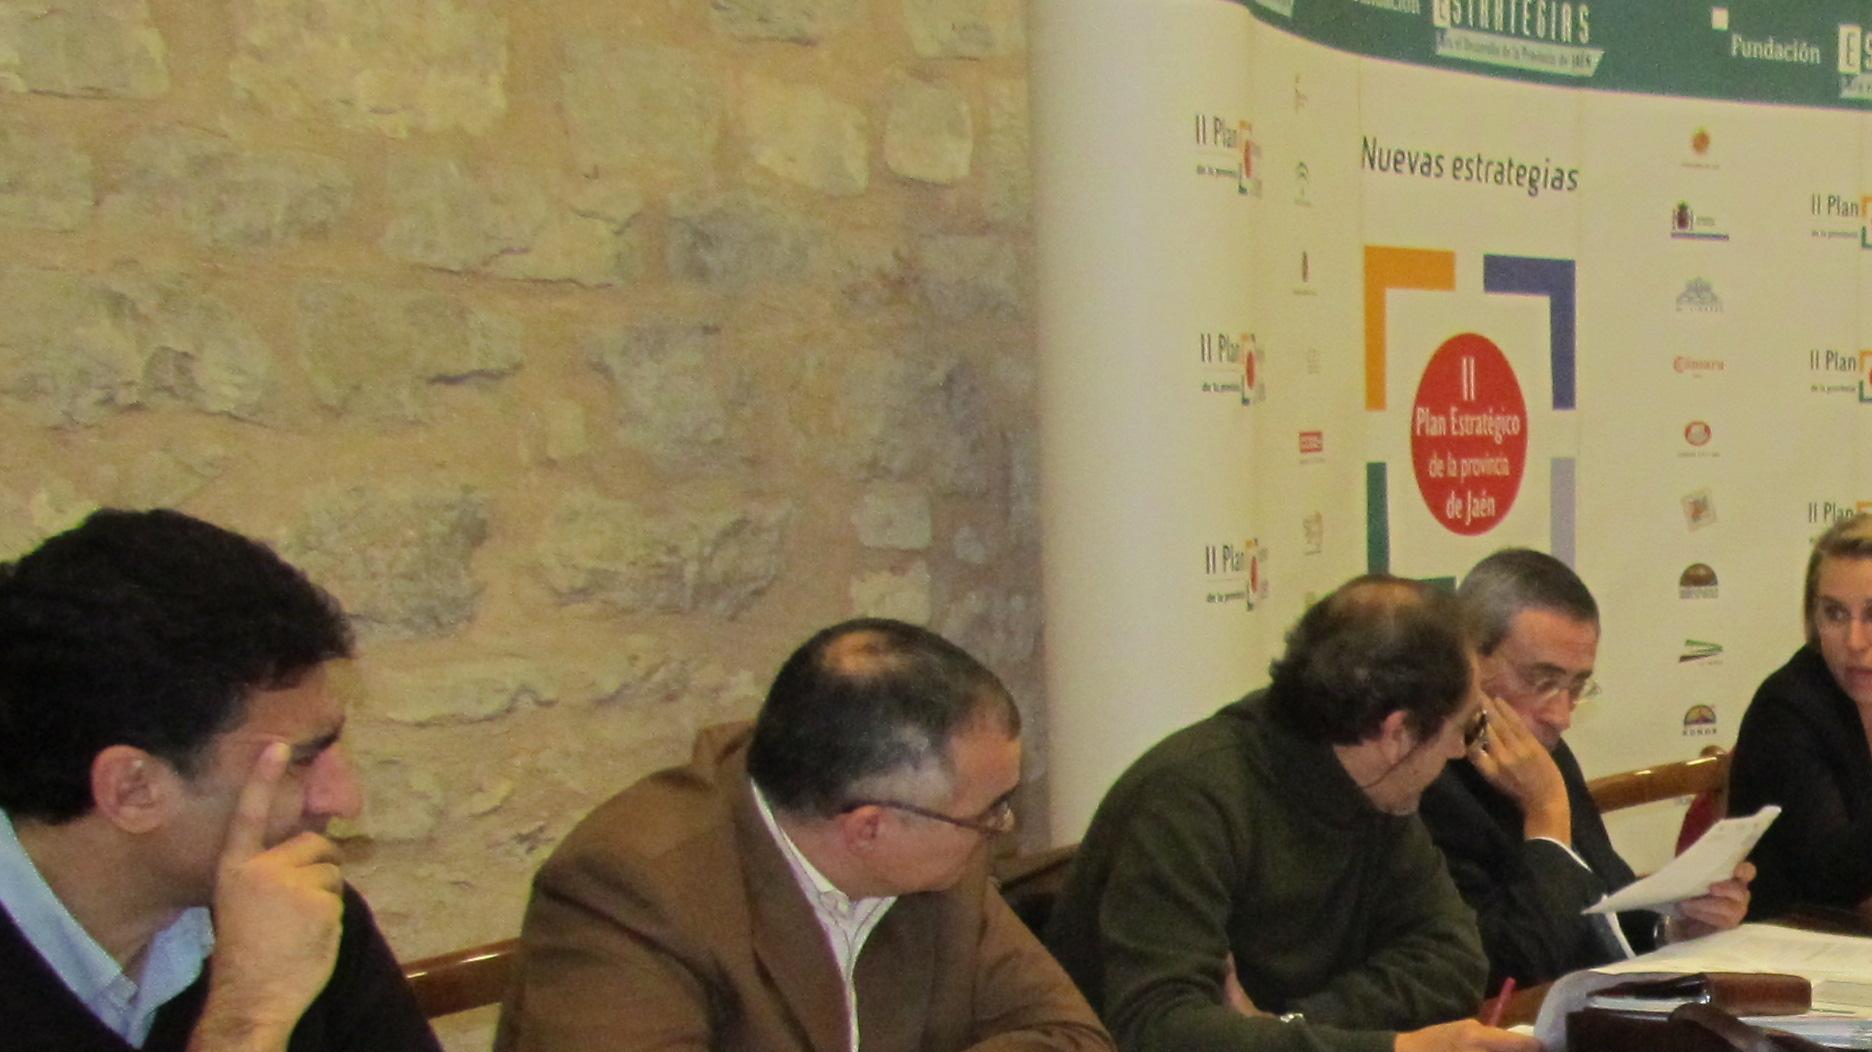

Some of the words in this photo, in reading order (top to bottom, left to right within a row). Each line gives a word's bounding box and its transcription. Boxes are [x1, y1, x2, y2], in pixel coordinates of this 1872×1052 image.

[1732, 34, 1820, 64] Fundación
[1361, 135, 1445, 178] Nuevas
[1452, 153, 1579, 197] estrategias
[1827, 194, 1859, 217] Plan
[1825, 350, 1857, 372] Plan
[1461, 356, 1476, 401] II
[1415, 406, 1446, 437] Plan
[1450, 405, 1521, 445] Estratégico
[1428, 454, 1445, 479] de
[1447, 452, 1458, 477] la
[1460, 453, 1511, 484] provincia
[1445, 490, 1463, 519] de
[1464, 489, 1496, 525] Jaén
